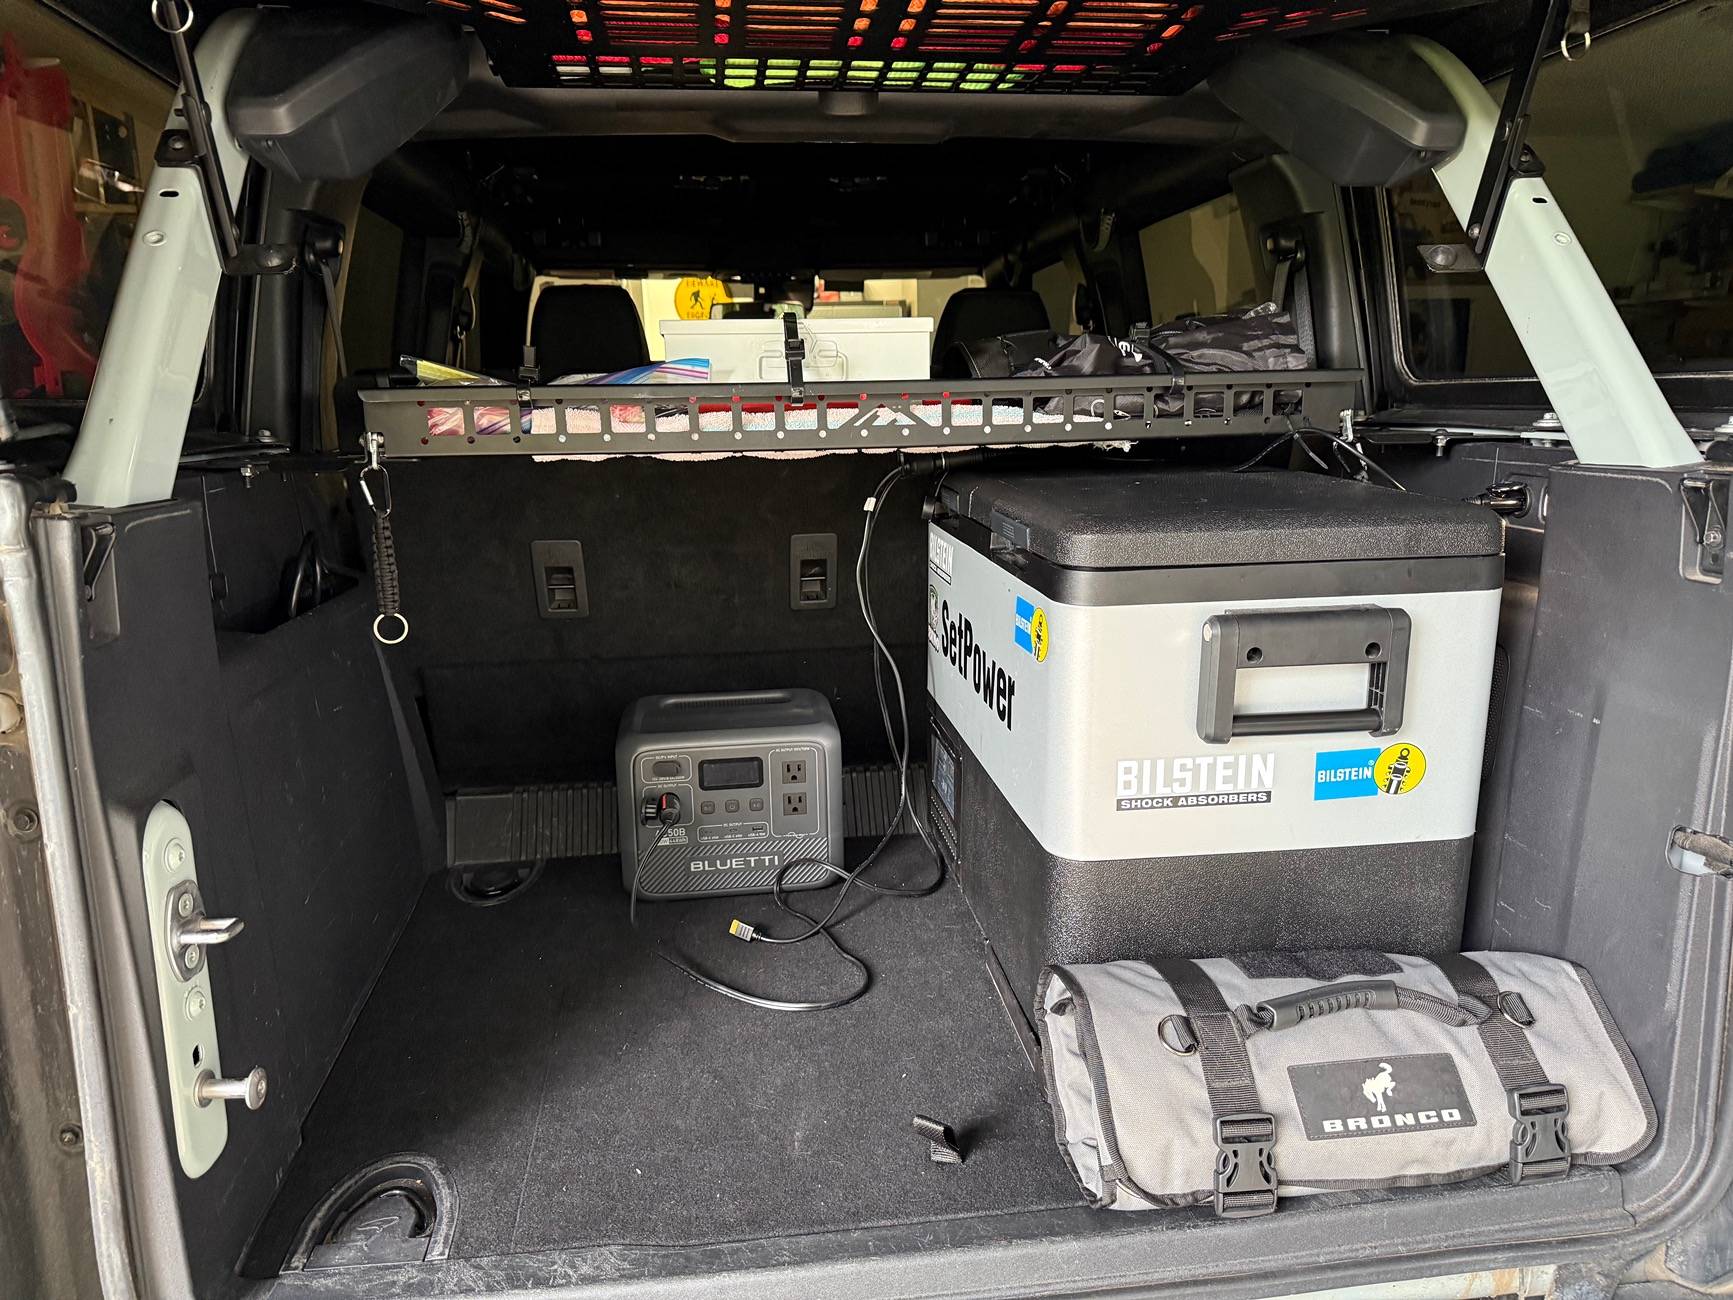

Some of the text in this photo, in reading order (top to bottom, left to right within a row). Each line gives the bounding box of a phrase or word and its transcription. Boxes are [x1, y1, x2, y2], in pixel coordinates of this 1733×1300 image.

[941, 599, 1016, 732] SetPower
[1117, 752, 1275, 796] BILSTEIN
[1317, 766, 1373, 783] BILSTEIN
[1120, 792, 1268, 809] SHOCK ABSORBERS
[690, 856, 779, 872] BLUETTI
[1322, 1108, 1461, 1132] BRONCO
